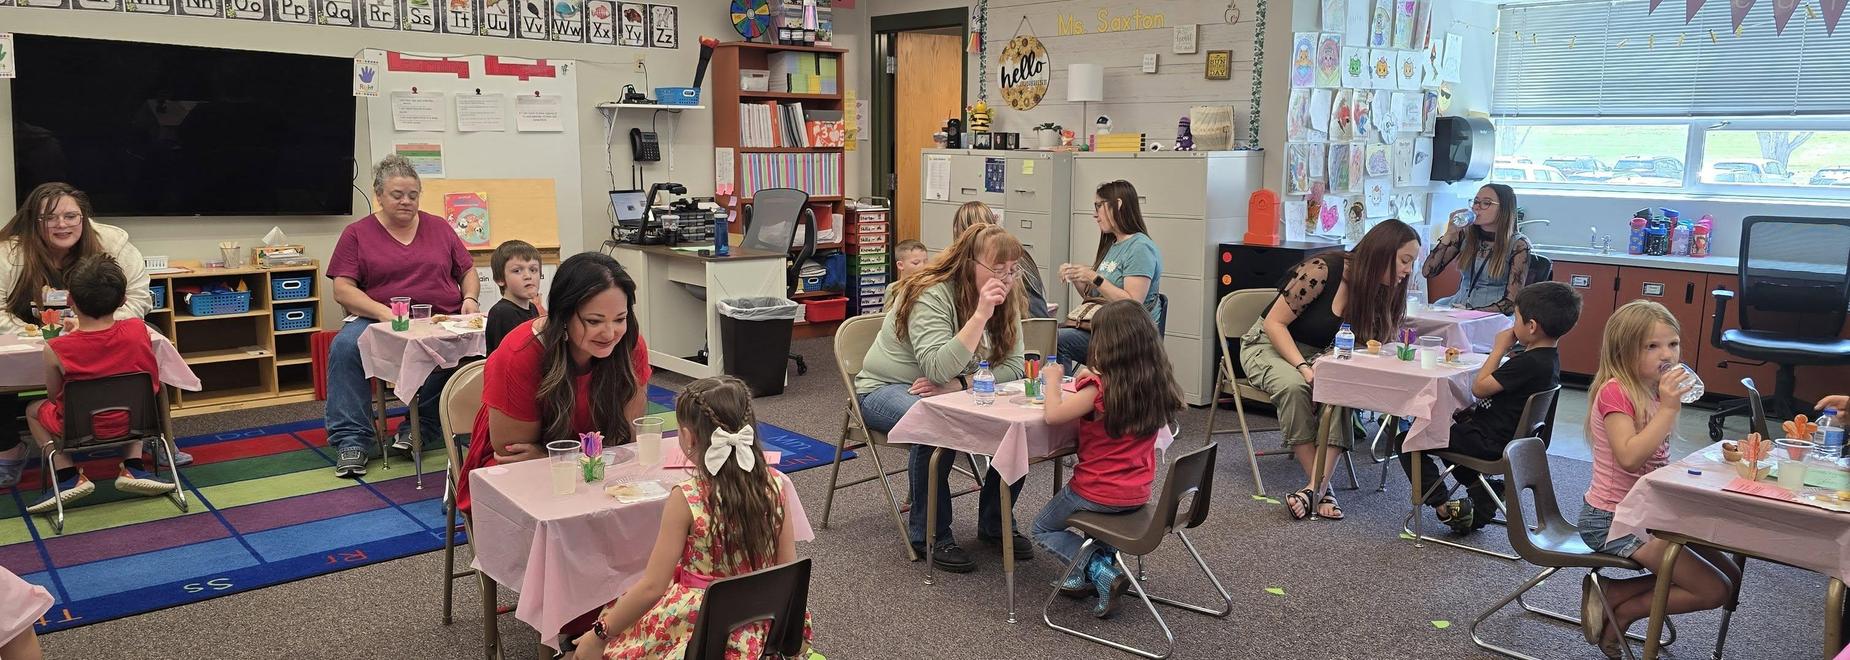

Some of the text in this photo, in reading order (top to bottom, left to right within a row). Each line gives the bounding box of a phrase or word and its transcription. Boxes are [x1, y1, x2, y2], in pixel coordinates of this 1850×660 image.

[235, 0, 261, 12] Oo
[283, 0, 305, 20] Pp
[325, 1, 353, 24] Qq
[370, 4, 391, 22] Rr
[411, 7, 431, 25] Ss
[451, 10, 469, 28] Tt
[487, 14, 507, 31] Uu
[522, 16, 542, 33] Vv
[554, 19, 582, 37] Ww
[593, 21, 610, 39] Xx
[626, 24, 642, 44] Yy
[656, 28, 672, 44] Zz
[1097, 7, 1164, 32] Saxton
[1001, 50, 1047, 88] hello
[183, 578, 233, 593] Ss
